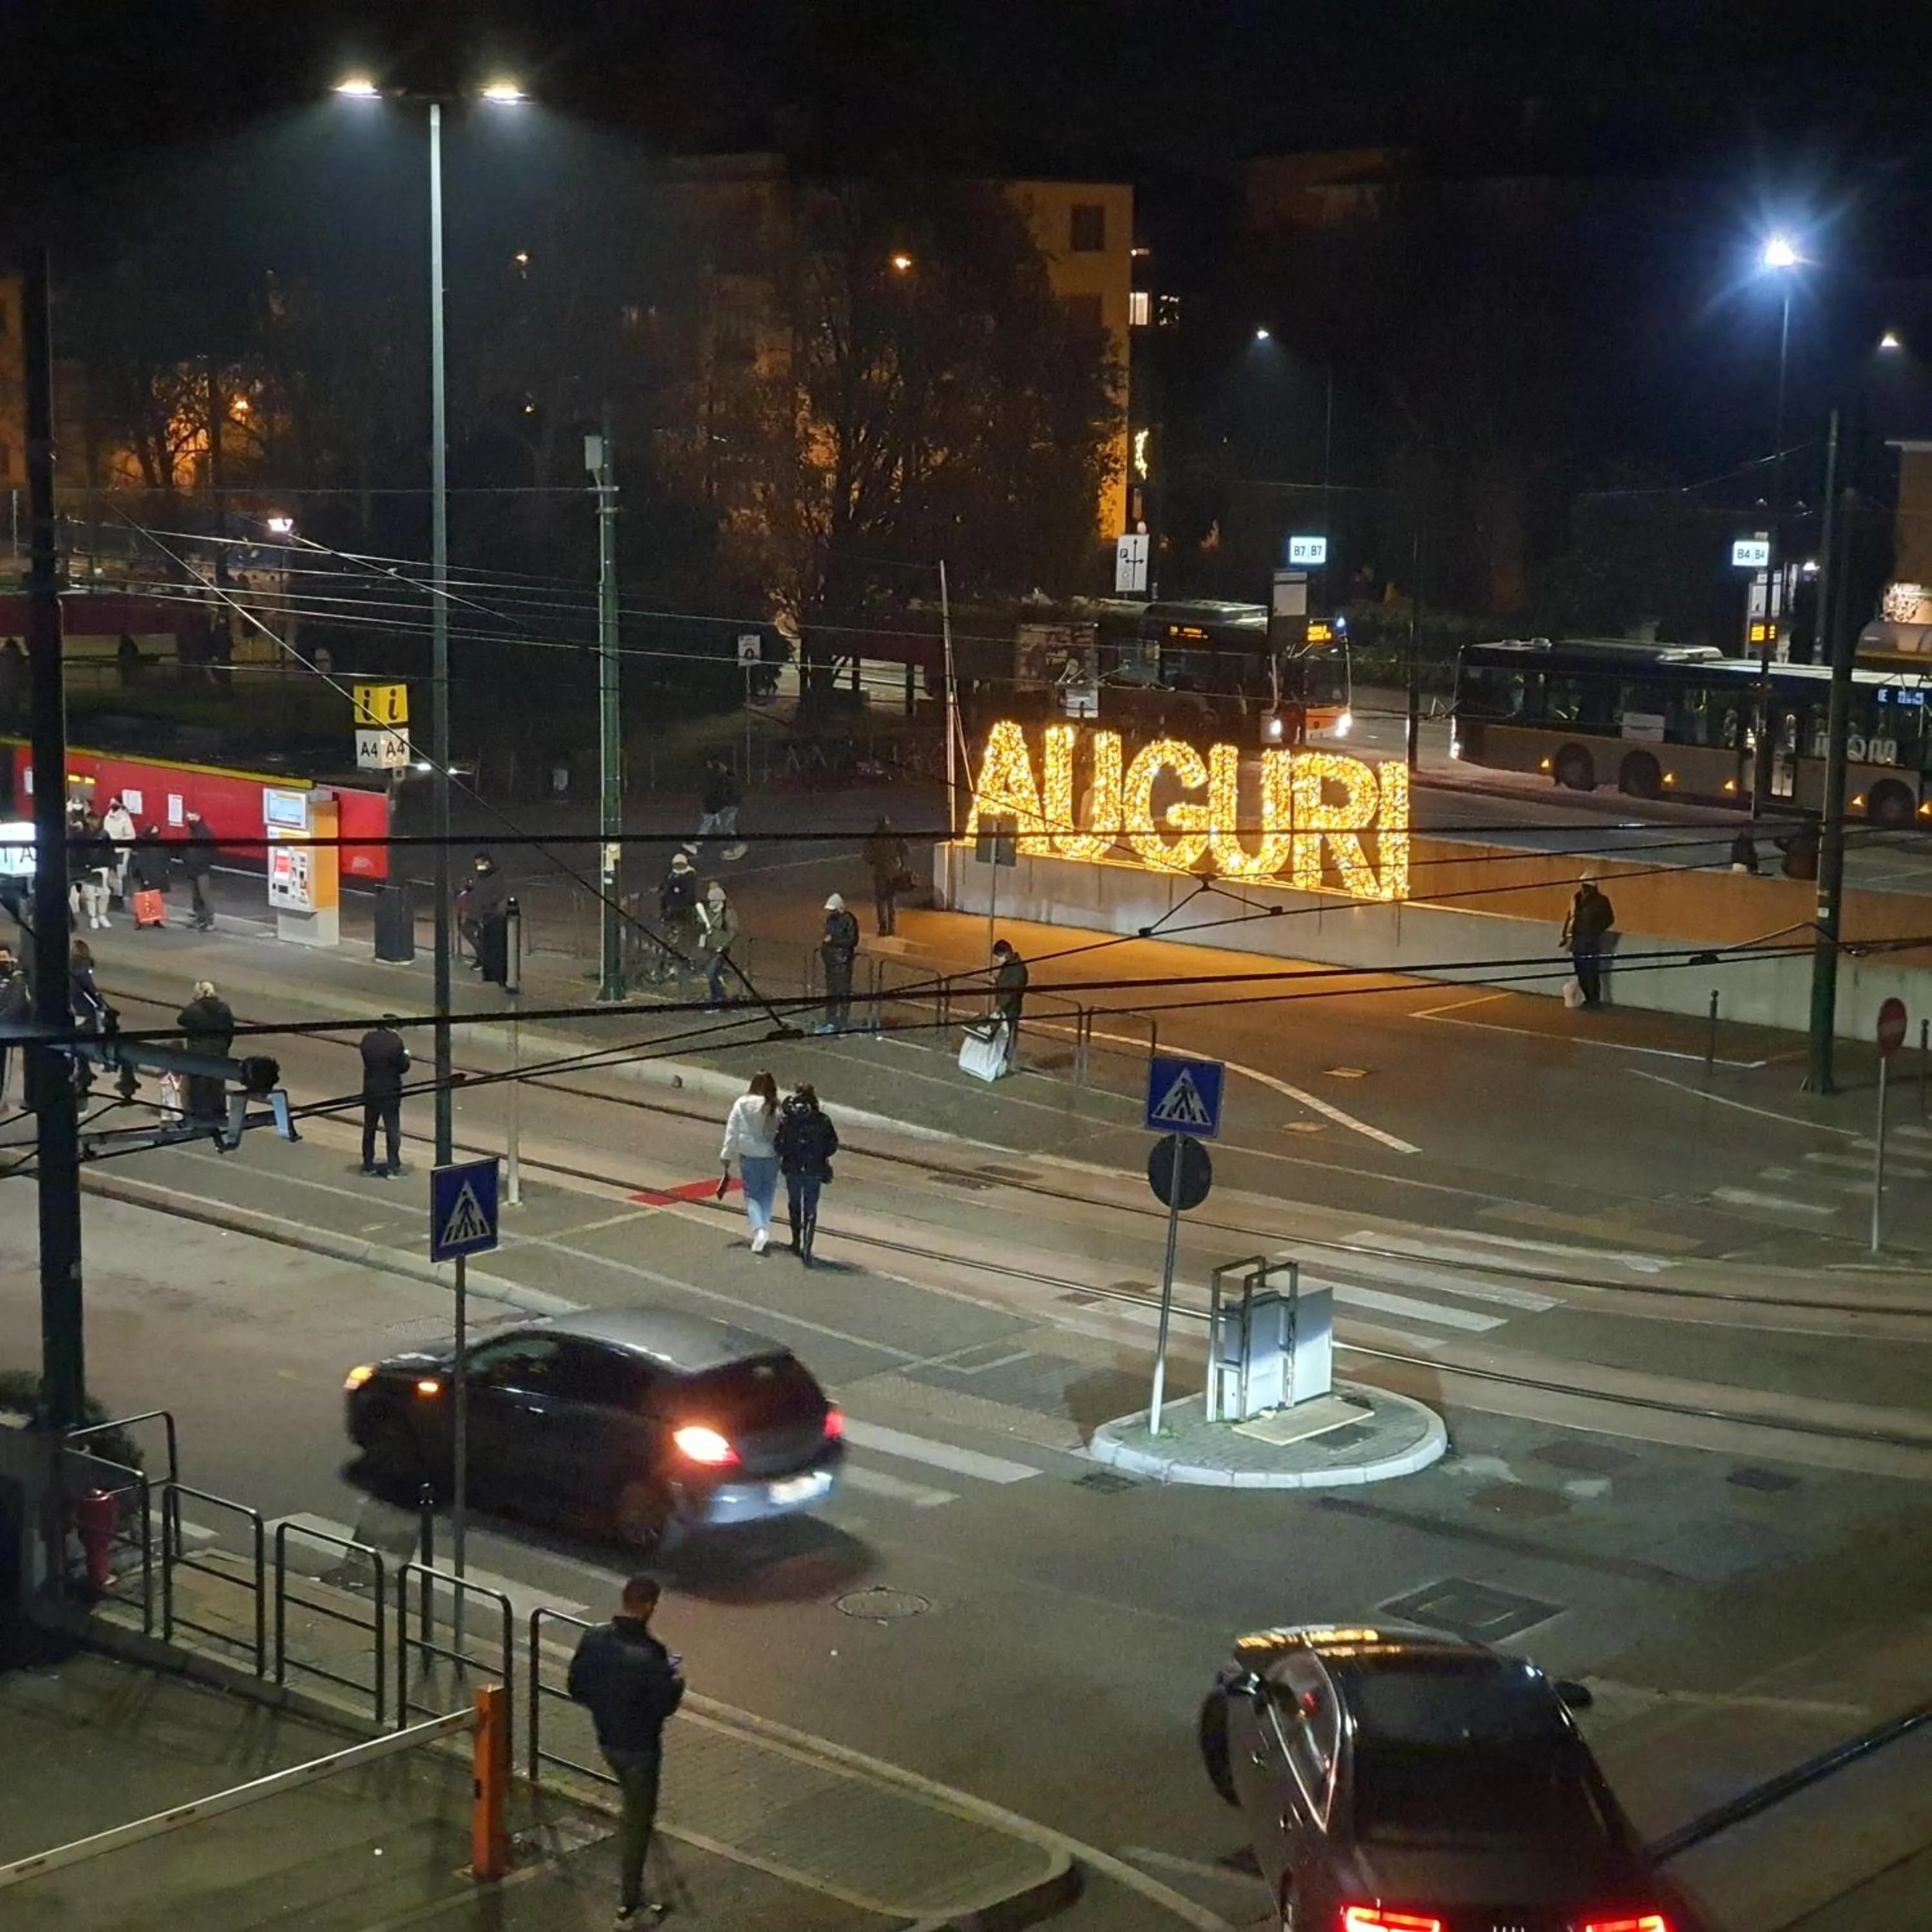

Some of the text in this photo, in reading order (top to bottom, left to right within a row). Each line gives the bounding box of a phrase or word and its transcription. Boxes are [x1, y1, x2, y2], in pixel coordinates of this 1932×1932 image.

[1294, 545, 1322, 556] B7 B7
[1737, 548, 1750, 559] B4
[361, 741, 405, 758] A4 A4
[966, 719, 1410, 902] AUGURI
